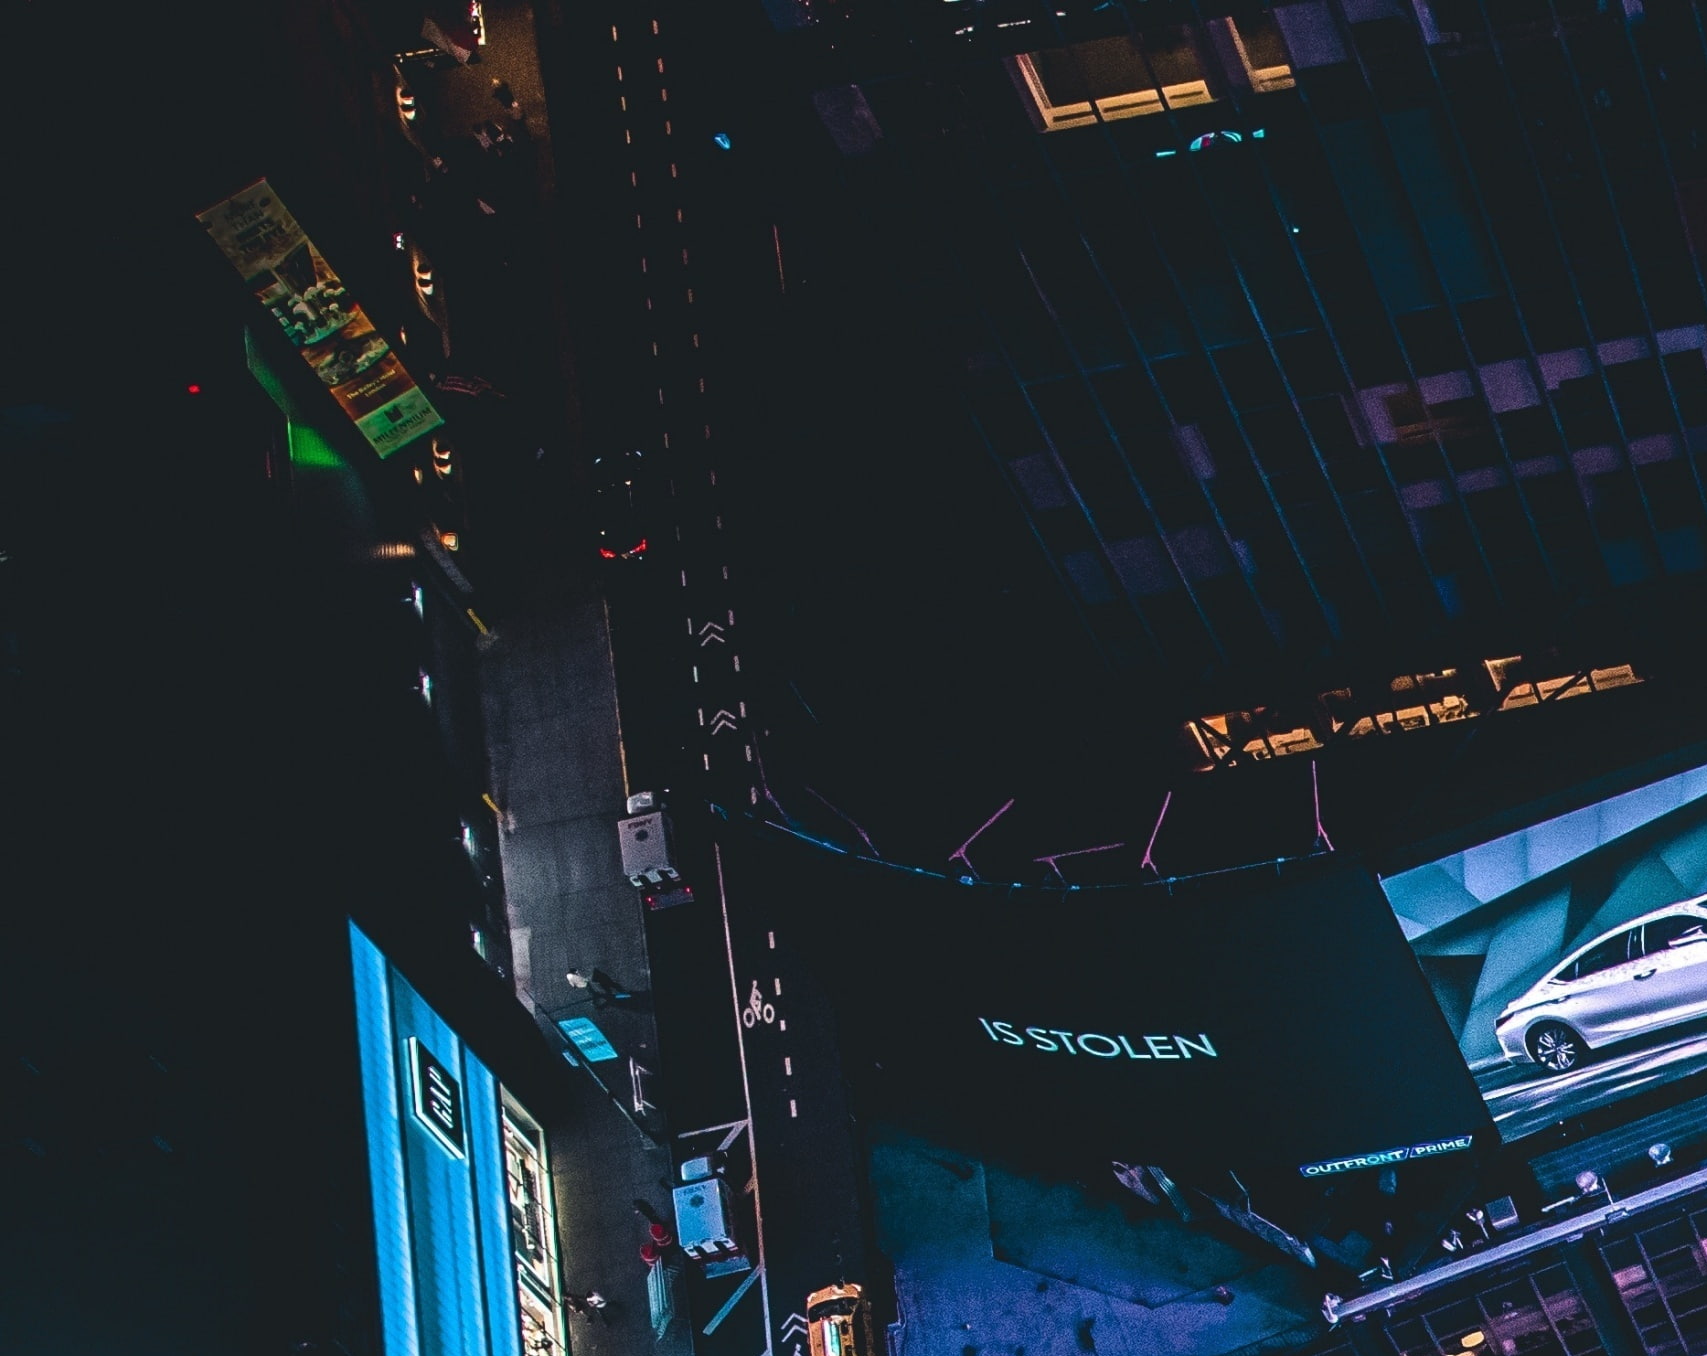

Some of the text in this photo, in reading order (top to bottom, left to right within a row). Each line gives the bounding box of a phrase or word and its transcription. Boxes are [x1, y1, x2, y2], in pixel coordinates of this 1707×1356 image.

[979, 1017, 1218, 1059] IS STOLEN
[428, 1066, 455, 1126] GAP
[1305, 1137, 1468, 1176] OUTFRONT PRIME
